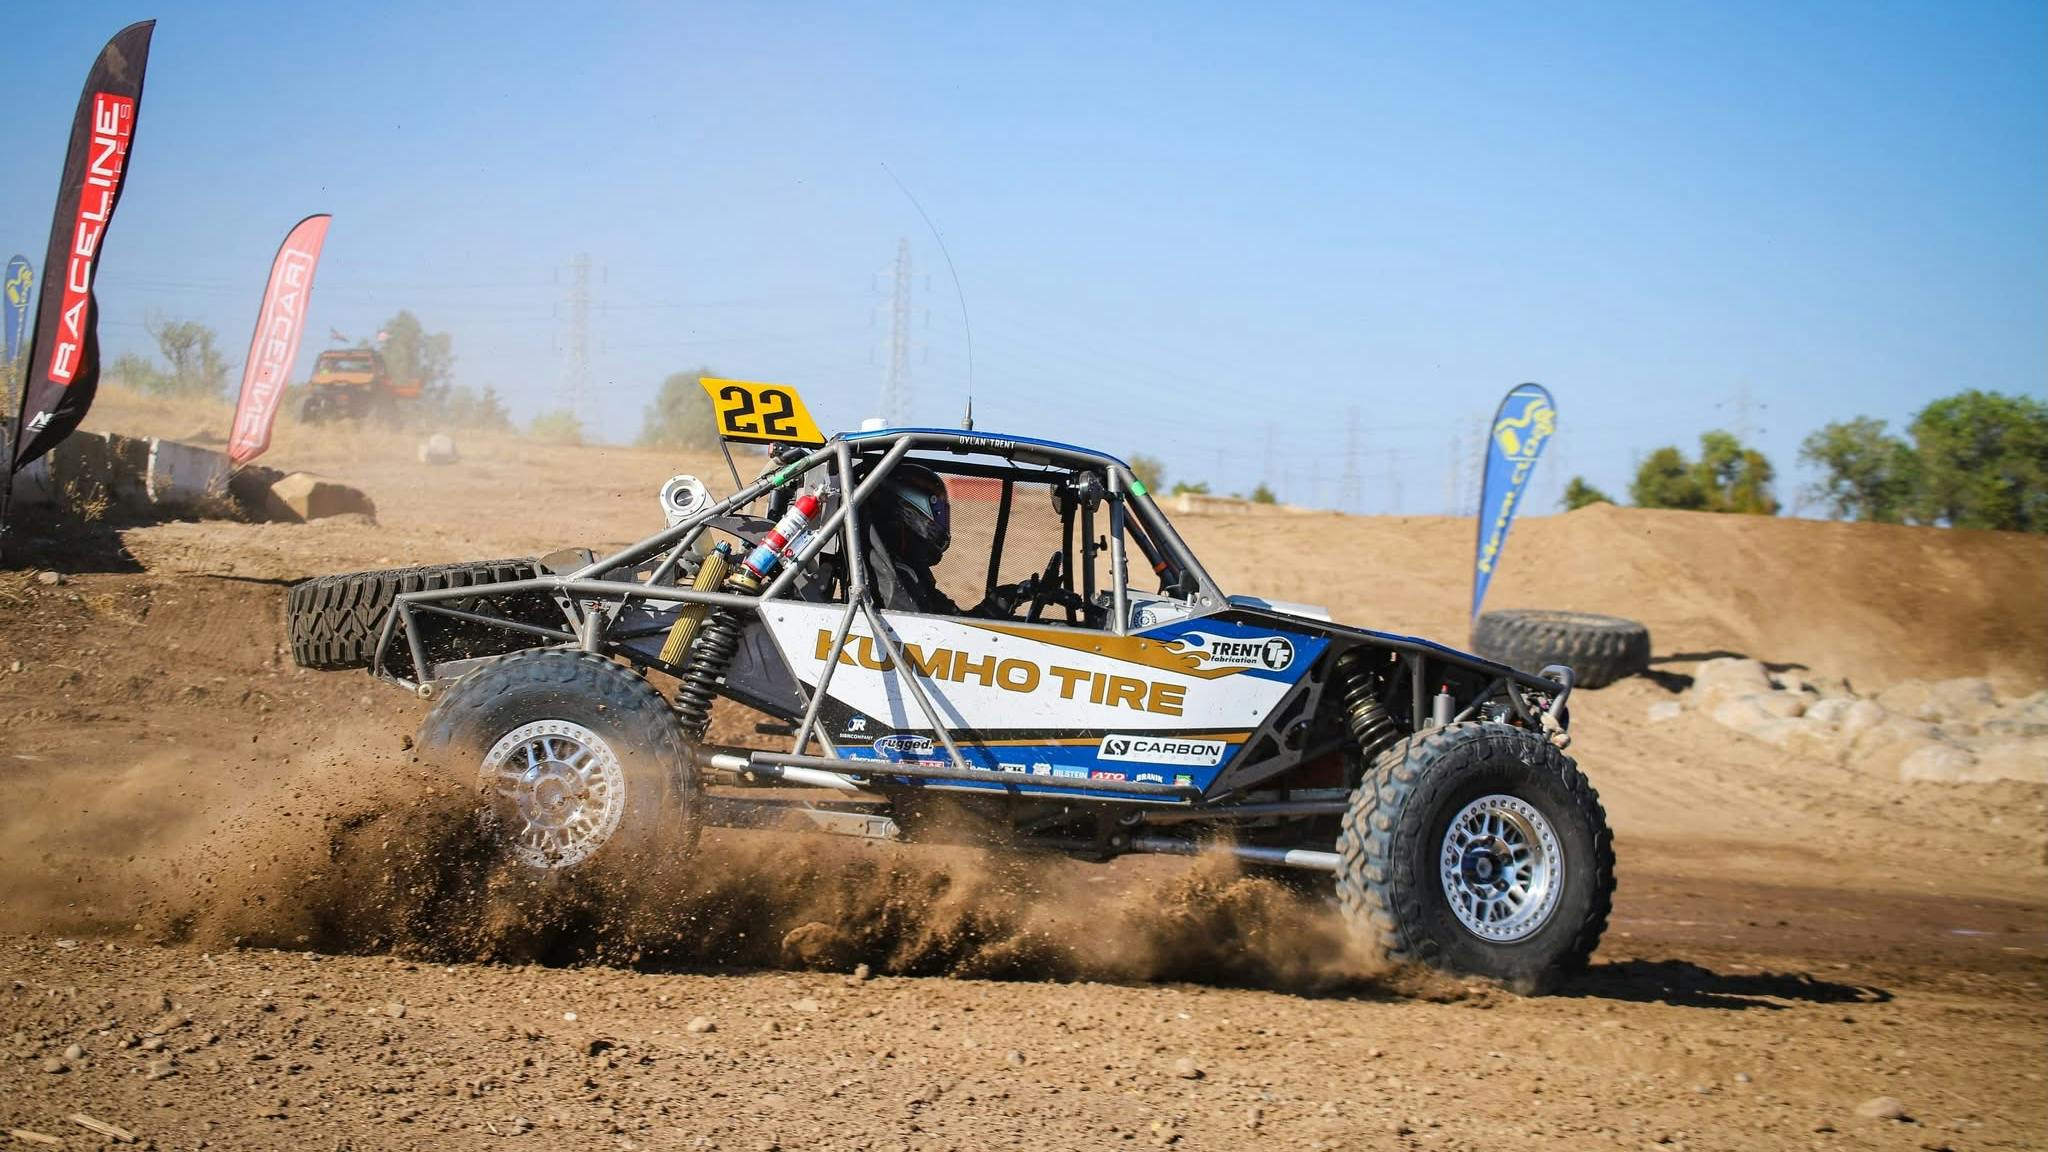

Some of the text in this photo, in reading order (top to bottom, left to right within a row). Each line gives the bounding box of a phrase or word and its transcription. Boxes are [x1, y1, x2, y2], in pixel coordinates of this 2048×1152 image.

[53, 99, 119, 378] RACELINE
[720, 386, 798, 436] 22
[959, 435, 1016, 449] DYLAN TRENT
[1211, 642, 1263, 657] TRENT
[1211, 655, 1257, 664] fabrication
[815, 629, 1187, 717] KUMHO TIRE
[1133, 741, 1221, 756] CARBON
